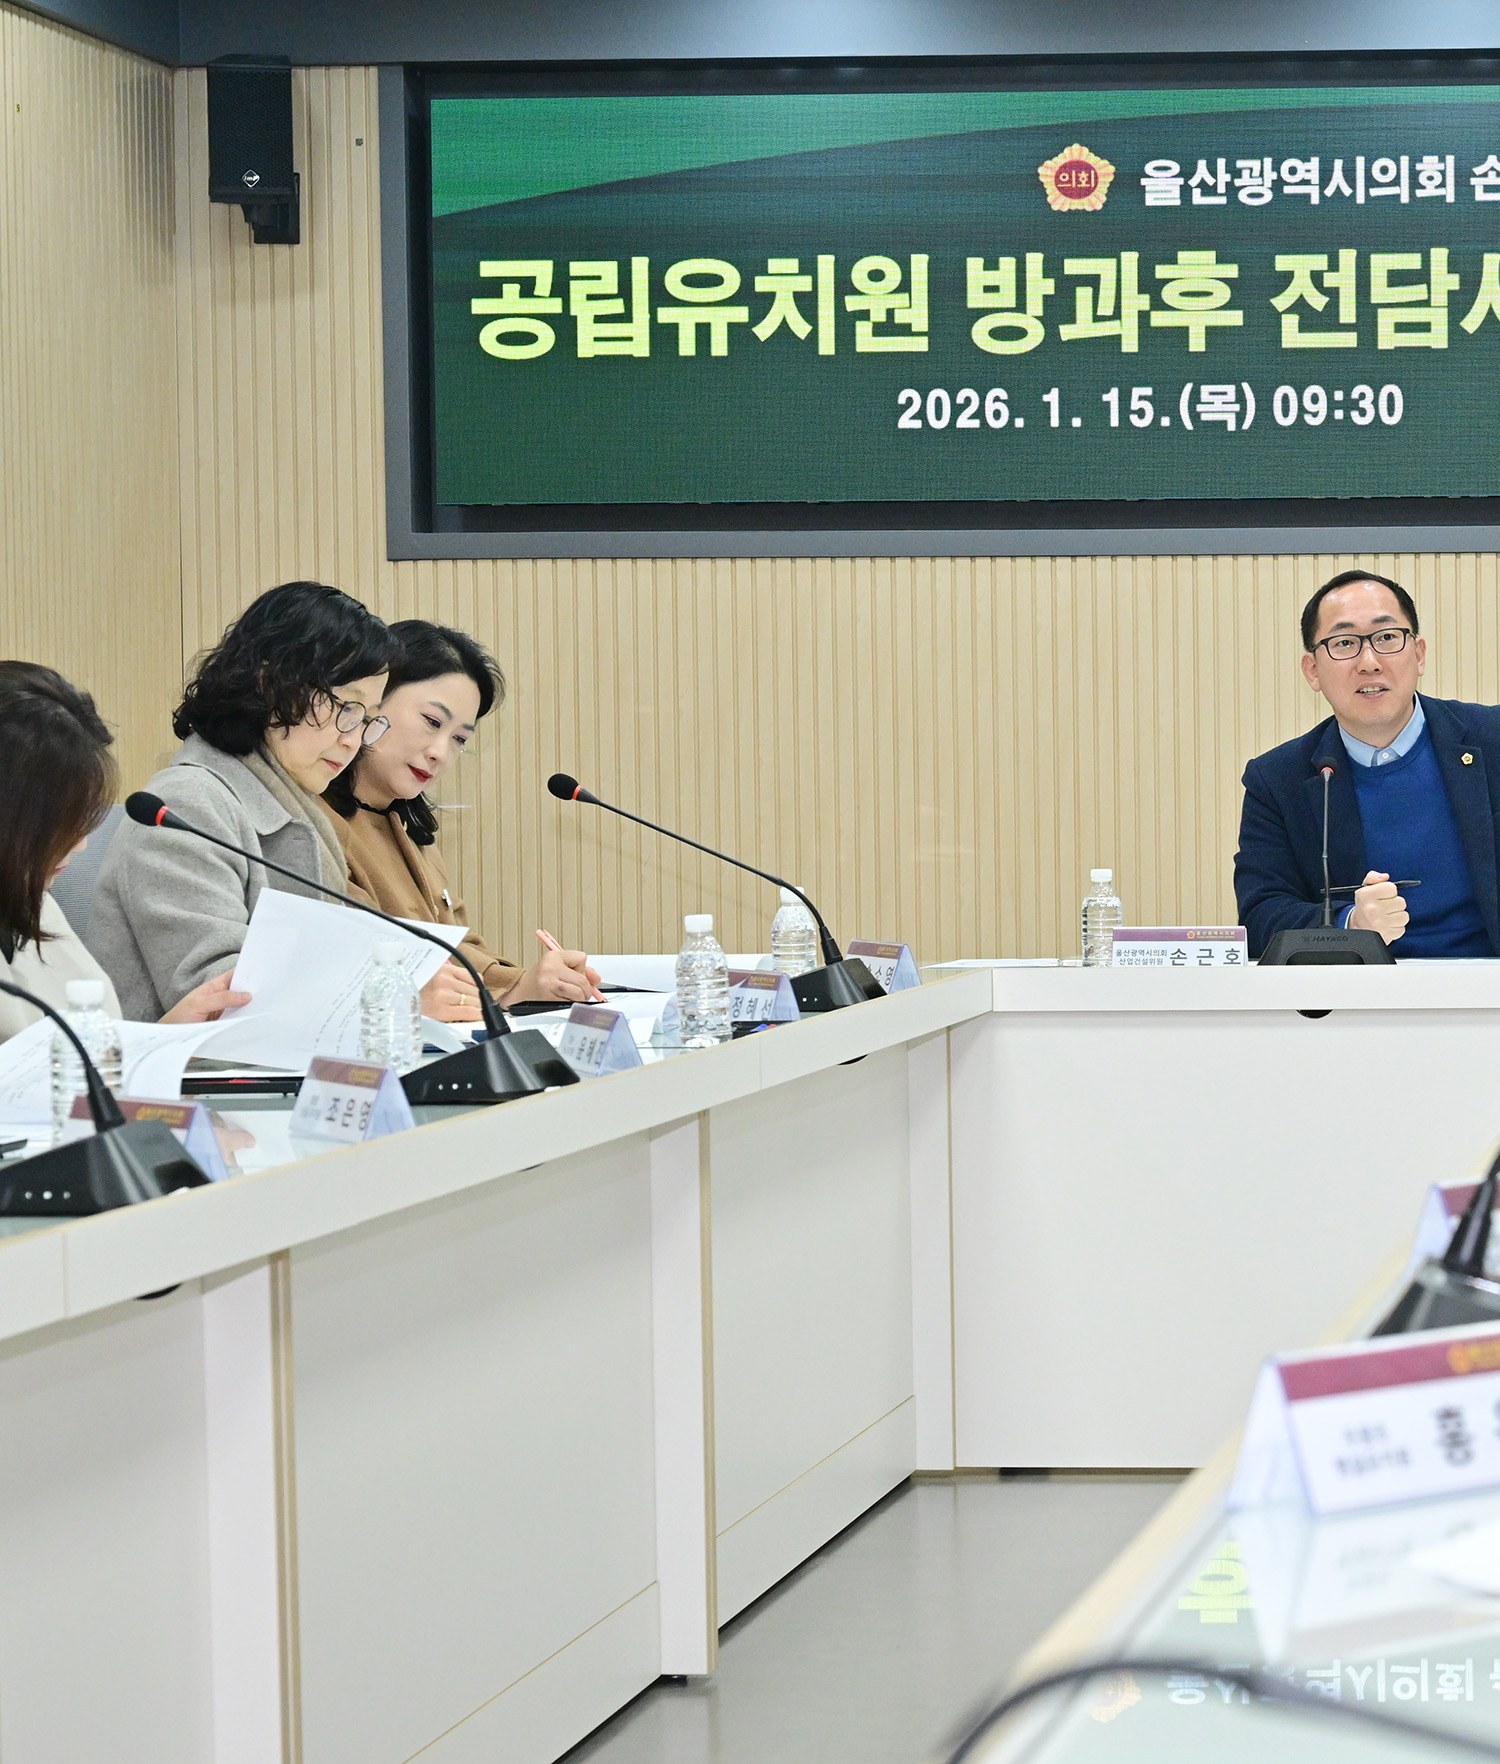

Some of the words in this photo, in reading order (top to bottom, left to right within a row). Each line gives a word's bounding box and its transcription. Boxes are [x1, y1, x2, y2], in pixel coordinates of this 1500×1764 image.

[1057, 169, 1095, 188] 의회
[1140, 153, 1456, 208] 울산광역시의회
[470, 253, 930, 361] 공립유치원
[965, 250, 1244, 356] 방과후
[897, 387, 1025, 430] 2026.
[1042, 387, 1082, 429] 1.
[1101, 381, 1256, 433] 15.(목)
[1272, 383, 1404, 427] 09:30
[1115, 949, 1168, 957] 울산광역시의회
